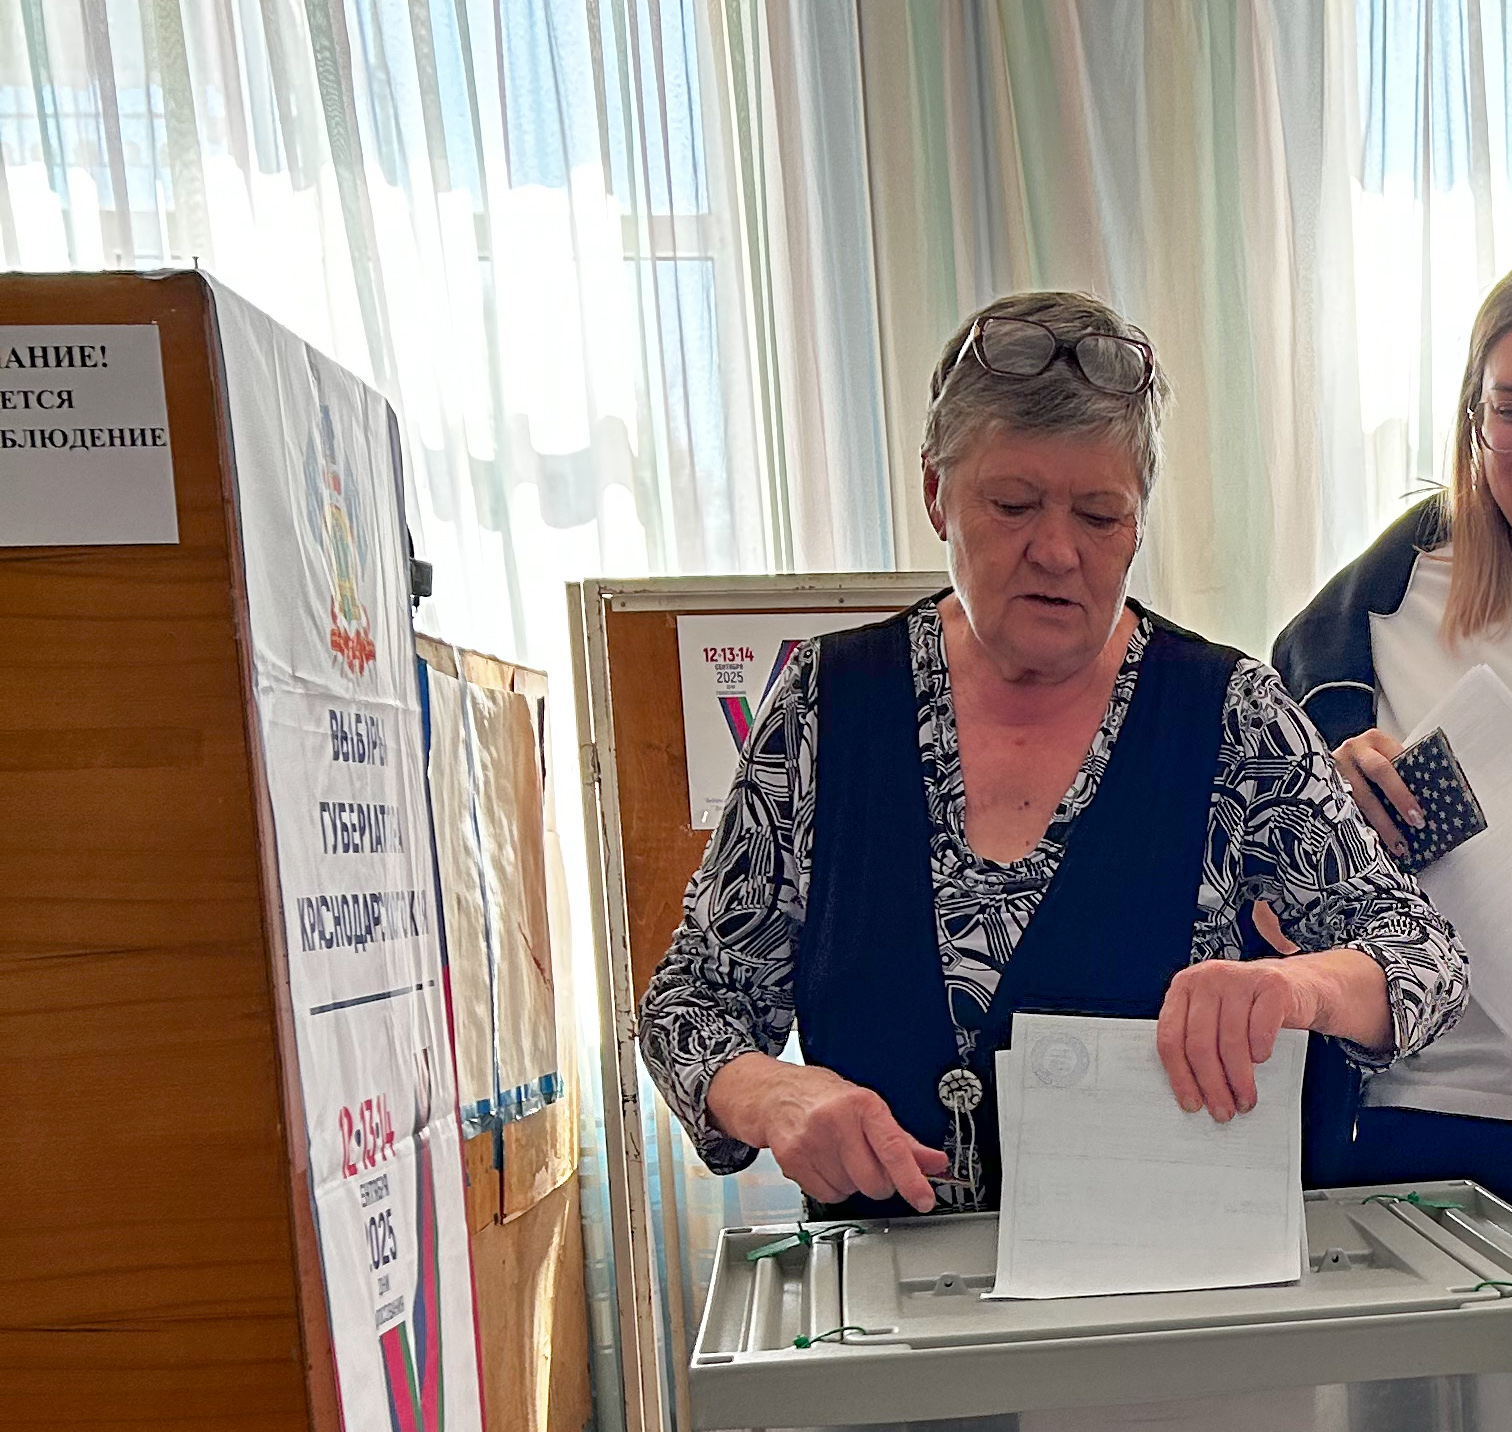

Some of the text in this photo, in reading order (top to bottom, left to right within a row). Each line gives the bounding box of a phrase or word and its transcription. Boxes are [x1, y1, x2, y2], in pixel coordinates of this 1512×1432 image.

[0, 345, 108, 369] АНИЕ!
[0, 427, 168, 451] БЛЮДЕНИЕ
[716, 671, 744, 684] 2025
[364, 1208, 398, 1272] 025
